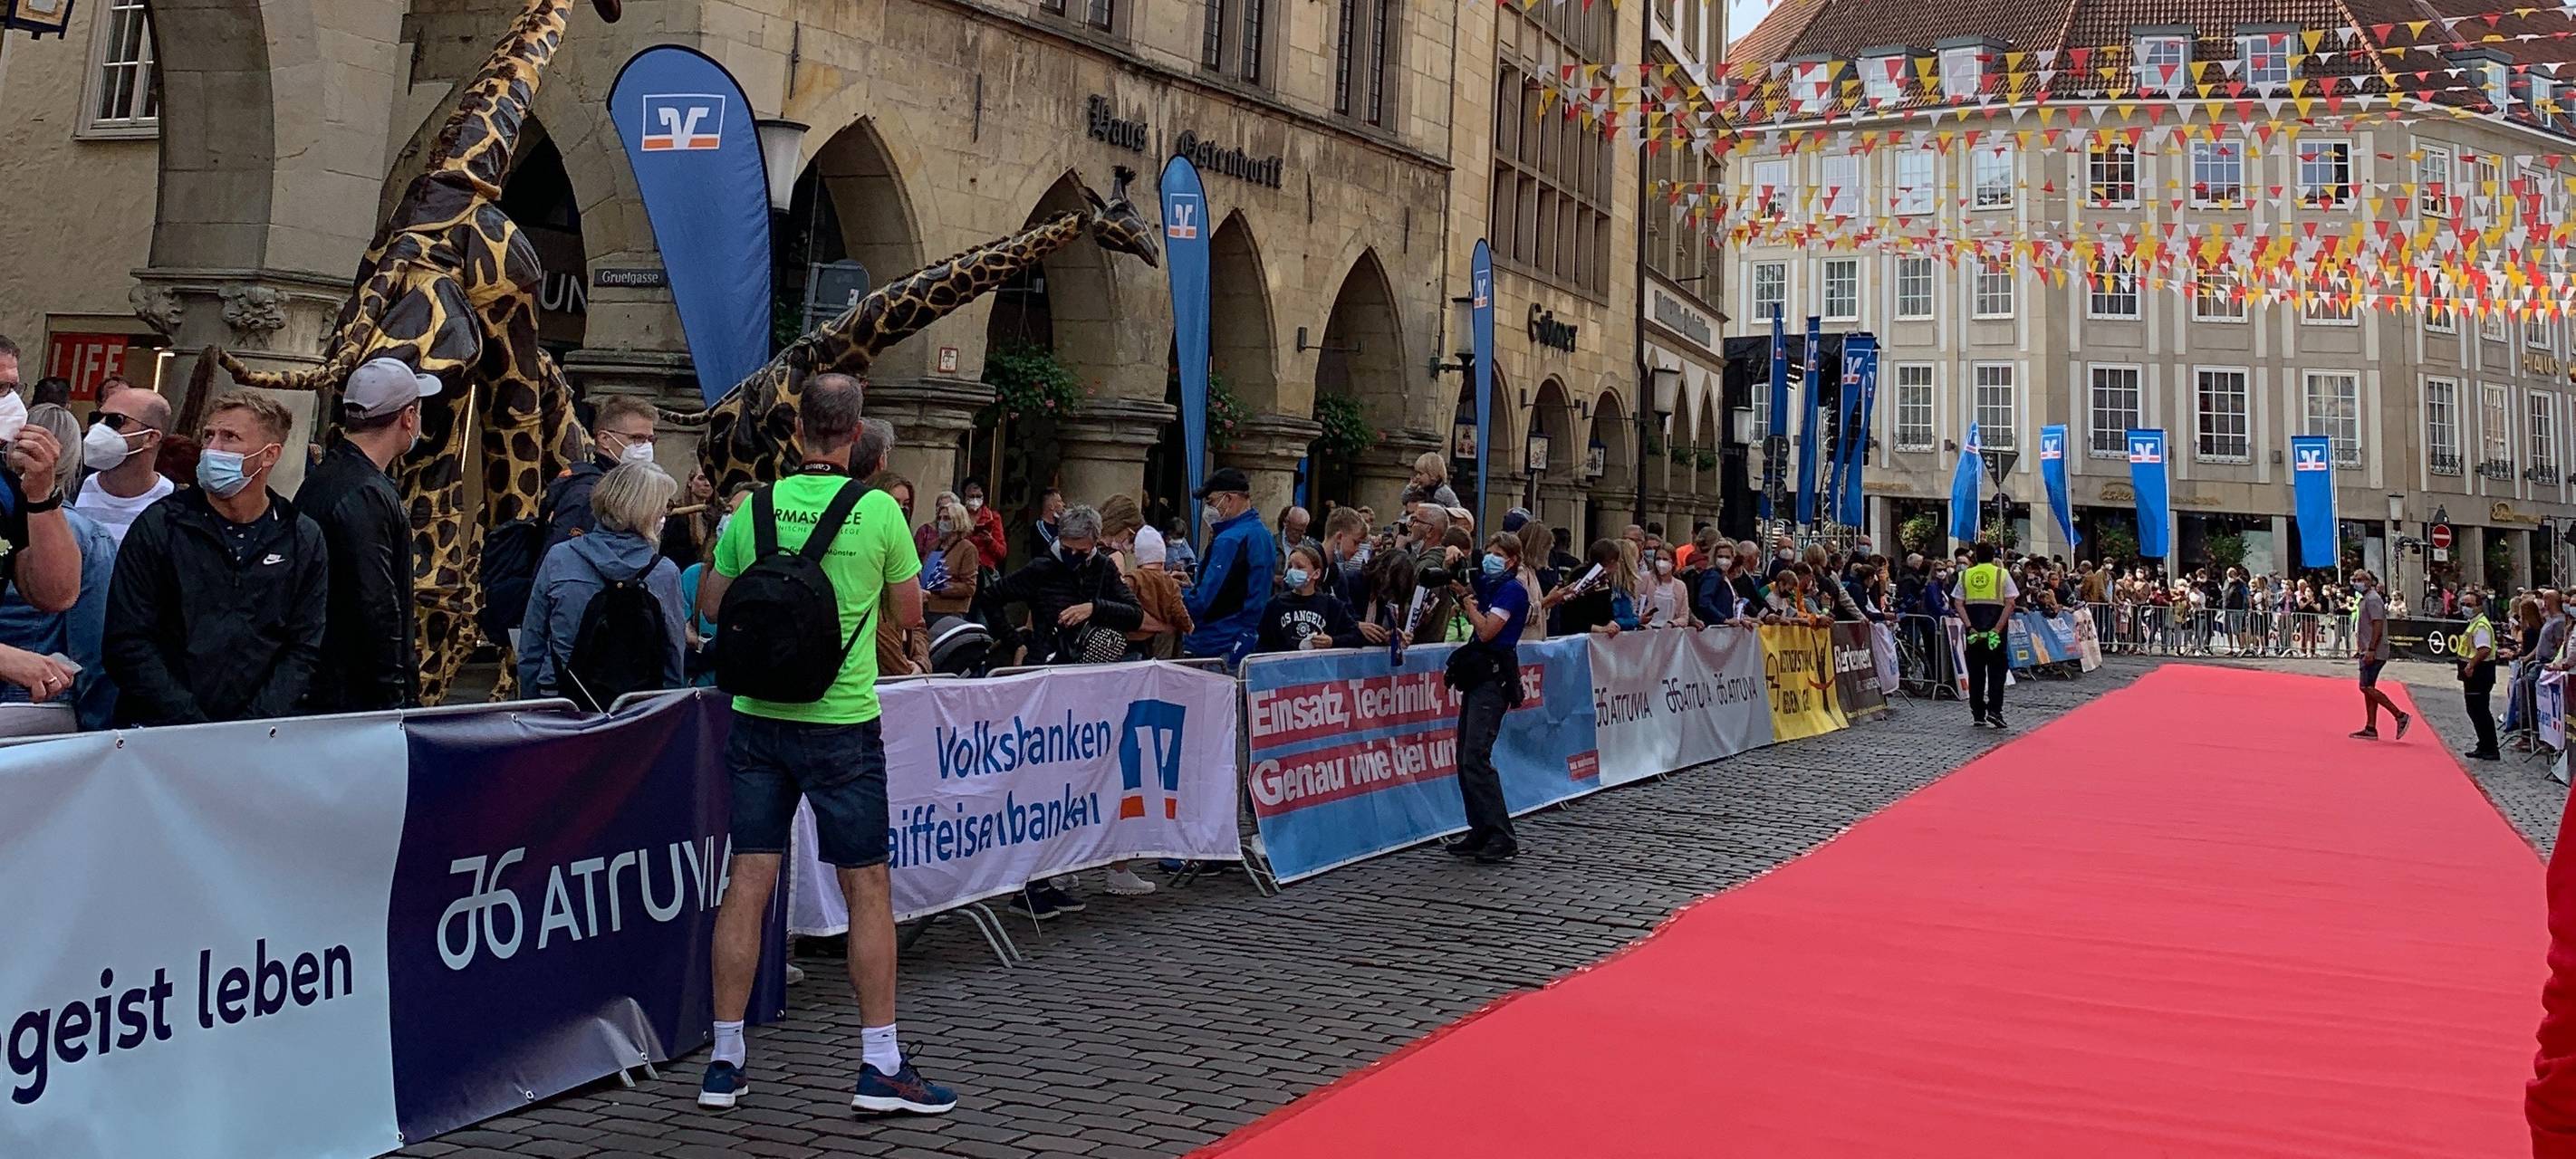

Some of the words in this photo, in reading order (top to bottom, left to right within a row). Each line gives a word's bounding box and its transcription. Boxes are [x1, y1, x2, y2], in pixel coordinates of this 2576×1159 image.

[2522, 352, 2561, 376] HAUS
[936, 709, 1111, 780] Volksbanken
[1252, 758, 1345, 806] Genau
[1350, 741, 1389, 786] wie
[1389, 733, 1426, 776] bei
[1429, 737, 1457, 770] un
[889, 783, 1101, 869] aiffeisenbanken
[0, 967, 173, 1105] geist
[198, 938, 352, 1029] leben
